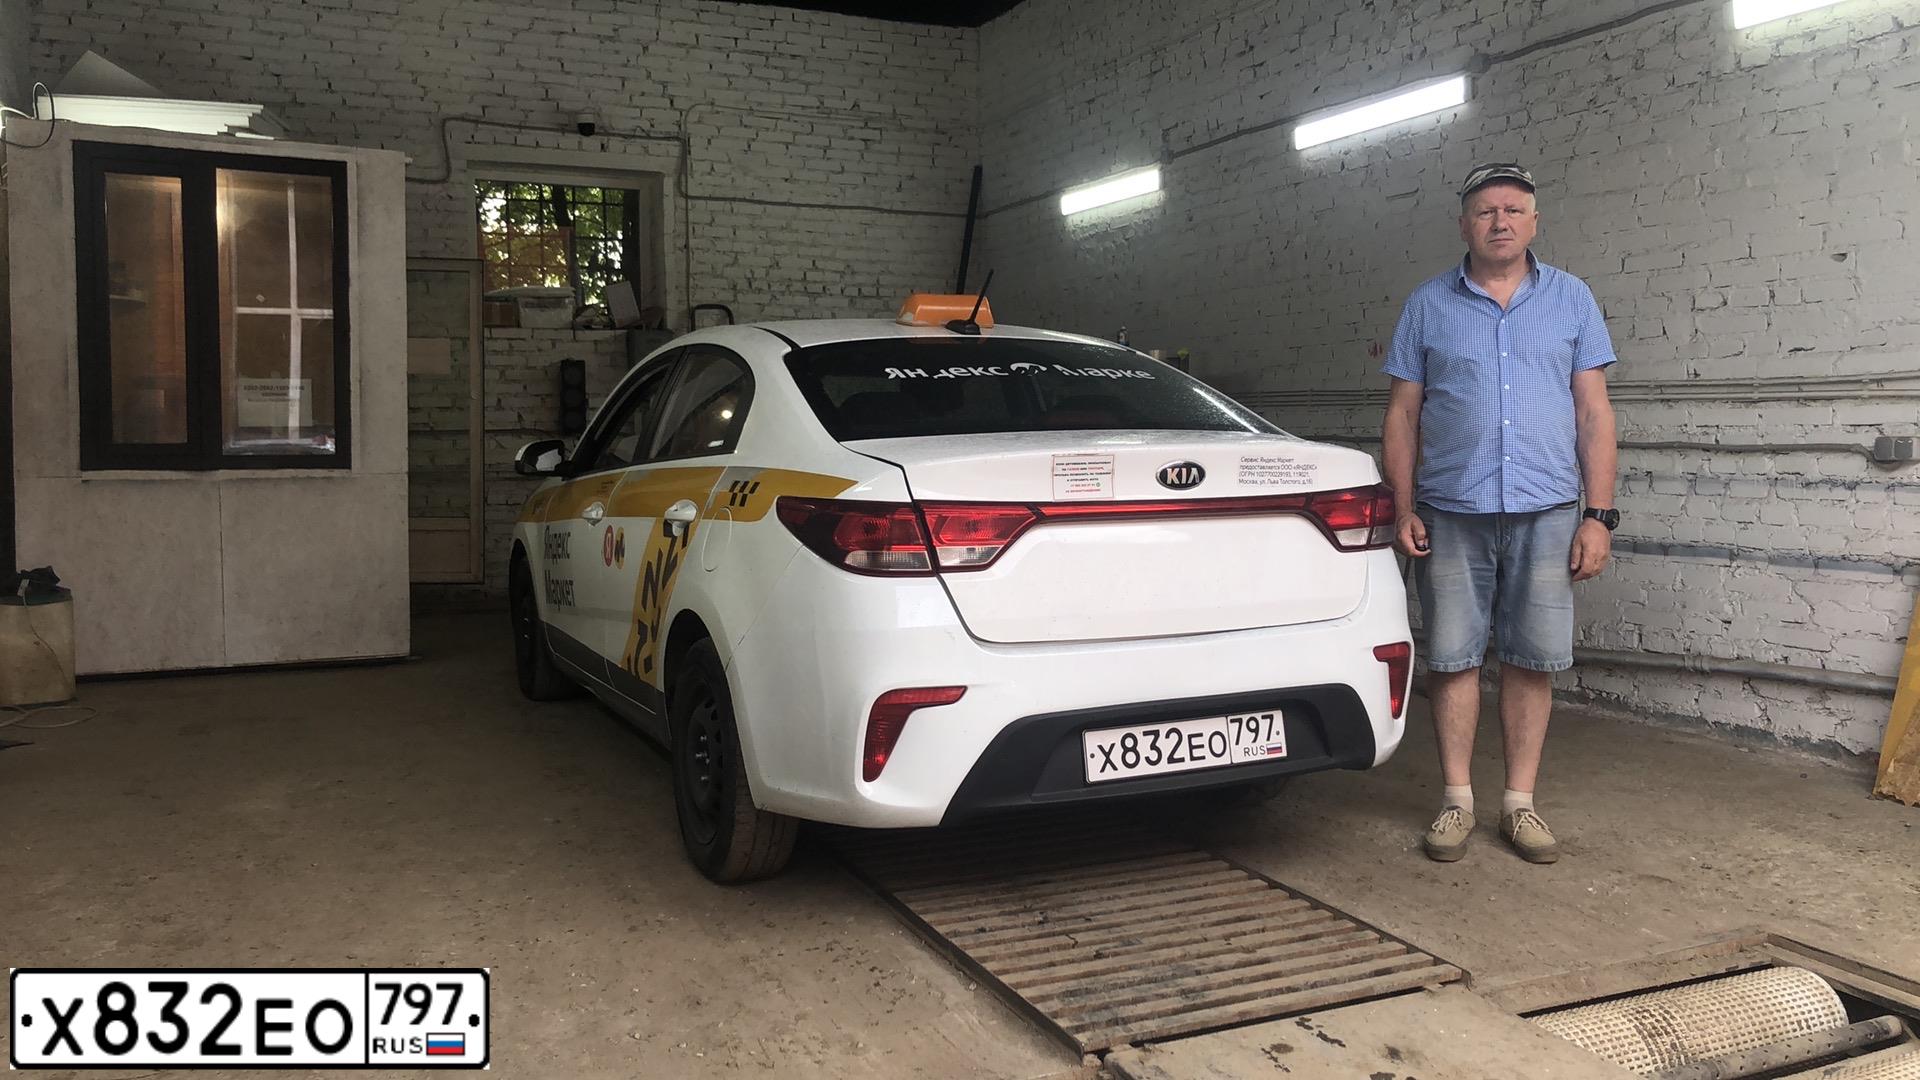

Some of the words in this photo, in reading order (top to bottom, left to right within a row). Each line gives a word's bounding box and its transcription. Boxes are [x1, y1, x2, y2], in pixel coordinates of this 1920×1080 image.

[1166, 467, 1200, 485] KIA
[544, 525, 571, 565] Яндекс
[544, 569, 576, 611] Маркет
[1229, 714, 1275, 746] 797
[1243, 745, 1266, 757] RUS
